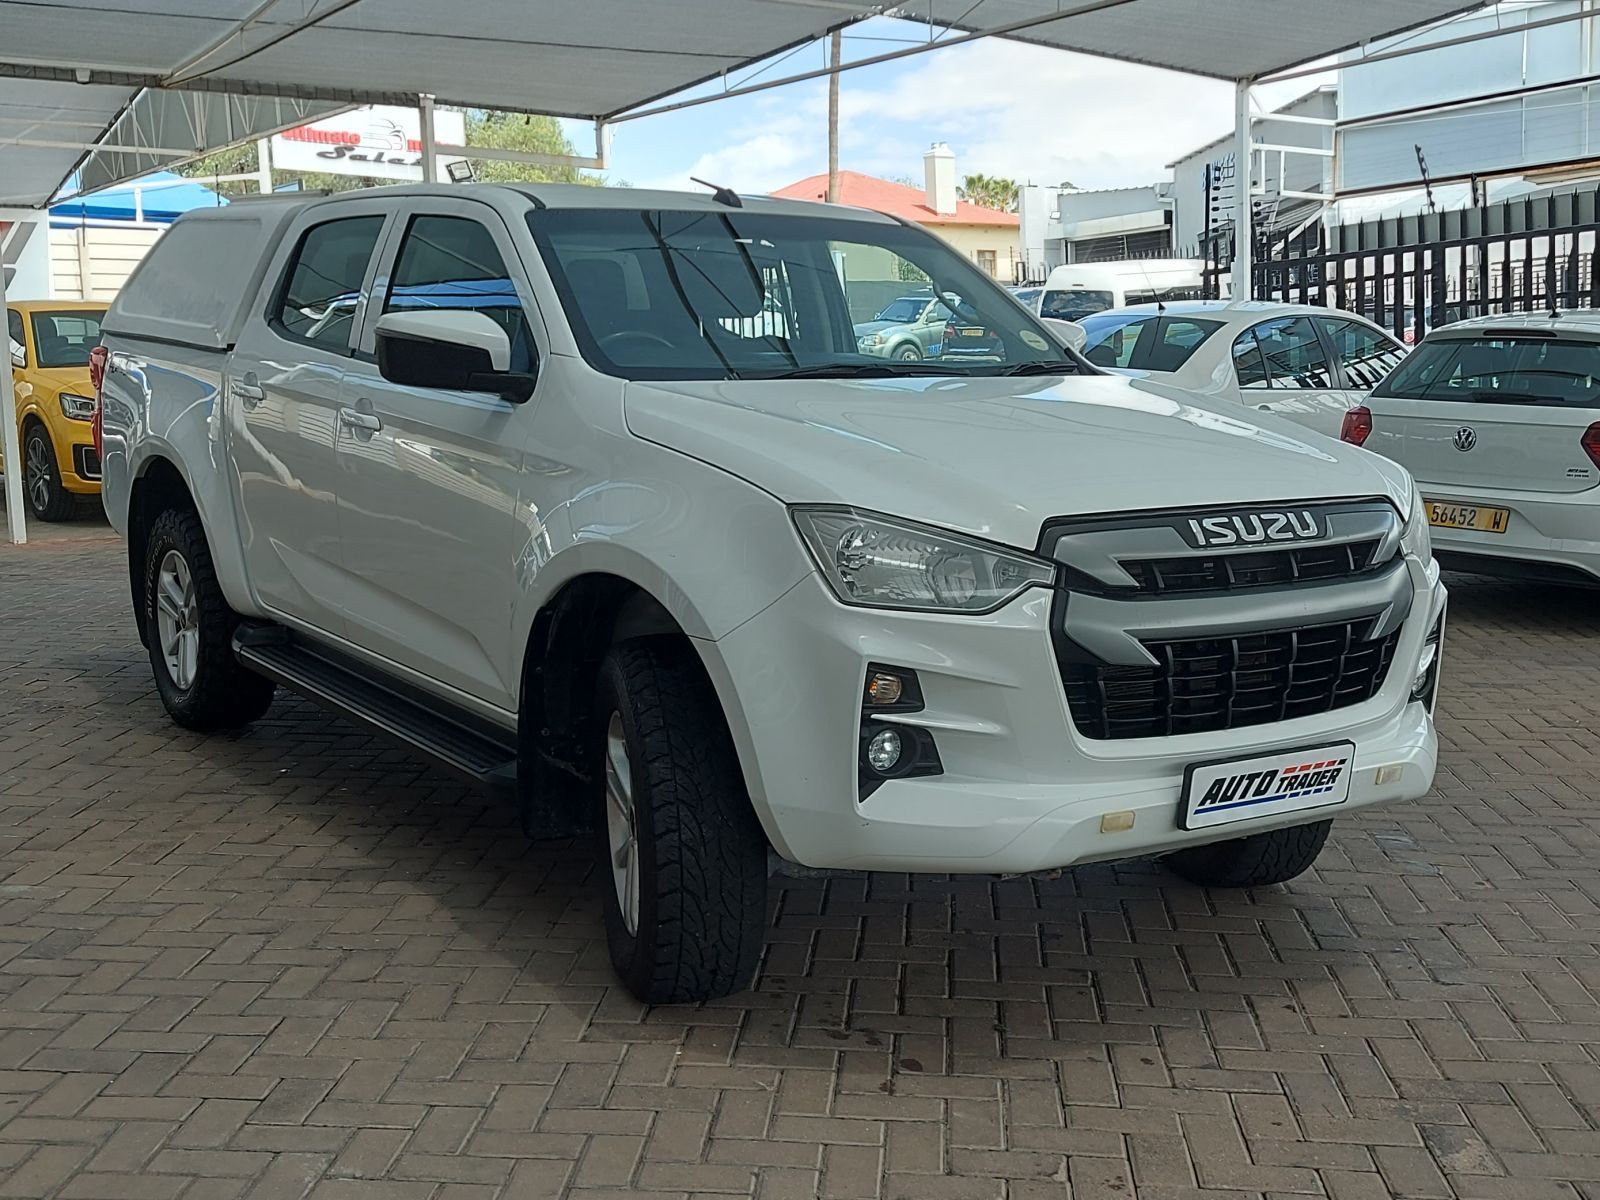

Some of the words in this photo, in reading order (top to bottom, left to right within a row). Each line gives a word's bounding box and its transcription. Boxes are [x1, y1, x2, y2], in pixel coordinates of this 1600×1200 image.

[1188, 511, 1318, 545] ISUZU
[1431, 505, 1477, 527] 56452
[1491, 511, 1503, 530] W
[1198, 769, 1280, 807] AUTO
[1275, 767, 1343, 794] TRADER
